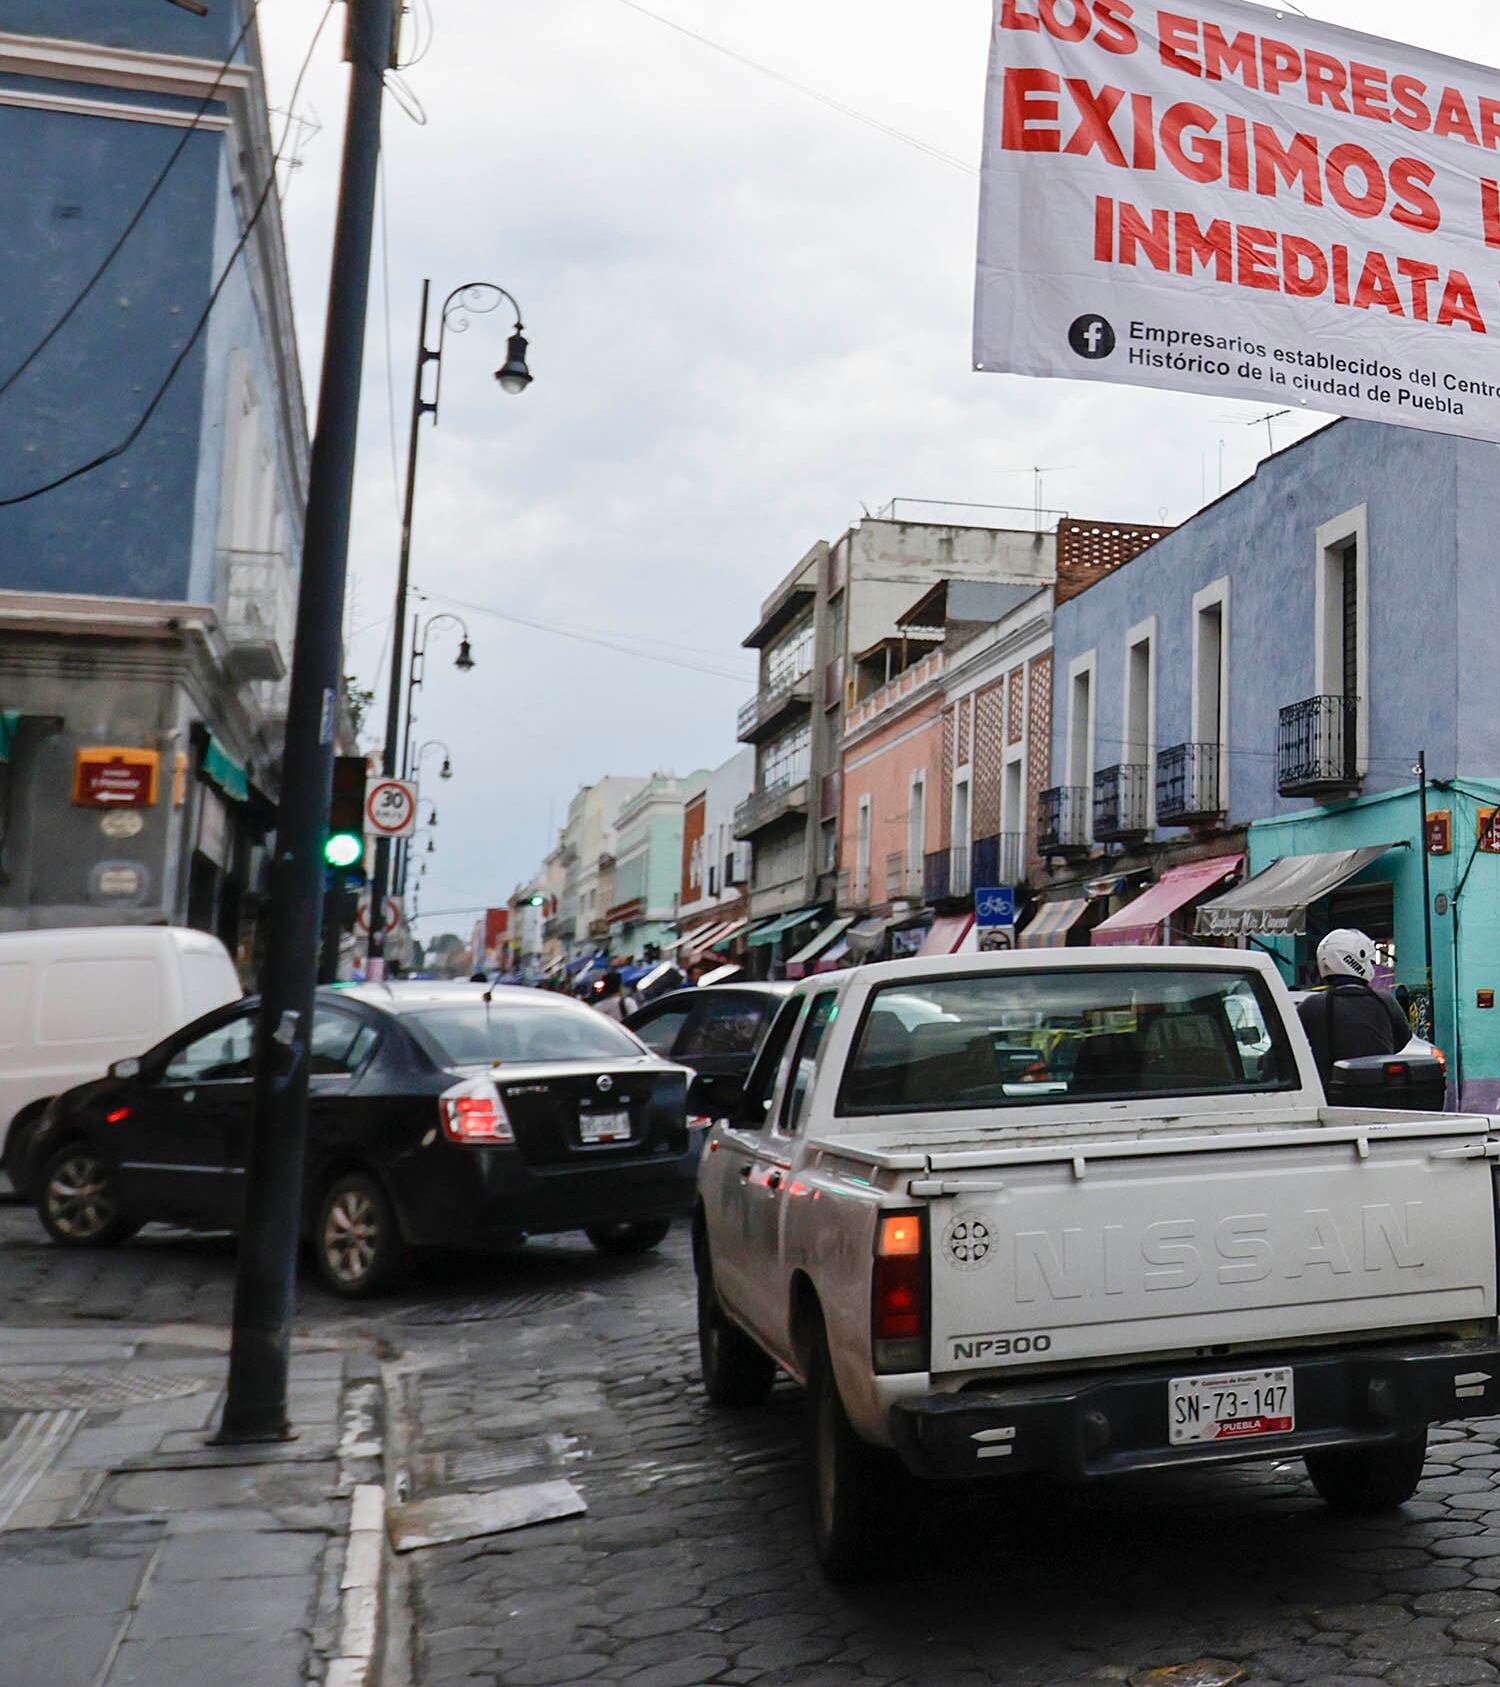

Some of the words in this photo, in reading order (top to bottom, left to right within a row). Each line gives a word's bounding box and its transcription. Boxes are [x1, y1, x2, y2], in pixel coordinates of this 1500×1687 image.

[1001, 0, 1138, 54] LOS
[1002, 68, 1440, 233] EXIGIMOS
[1095, 195, 1486, 333] INMEDIATA
[1129, 321, 1266, 357] Empresarios
[1273, 349, 1402, 380] establecidos
[1409, 369, 1437, 387] del
[1129, 347, 1230, 375] Histórico
[1237, 362, 1262, 380] de
[1270, 366, 1286, 385] la
[1293, 374, 1360, 398] ciudad
[1367, 385, 1391, 403] de
[1398, 389, 1464, 415] Puebla
[381, 790, 403, 809] 30
[1343, 954, 1366, 976] GHIRA
[1013, 1201, 1424, 1303] NISSAN
[953, 1335, 1052, 1360] NP300
[1175, 1386, 1287, 1423] SN-73-147
[1222, 1420, 1261, 1431] PUEBLA
